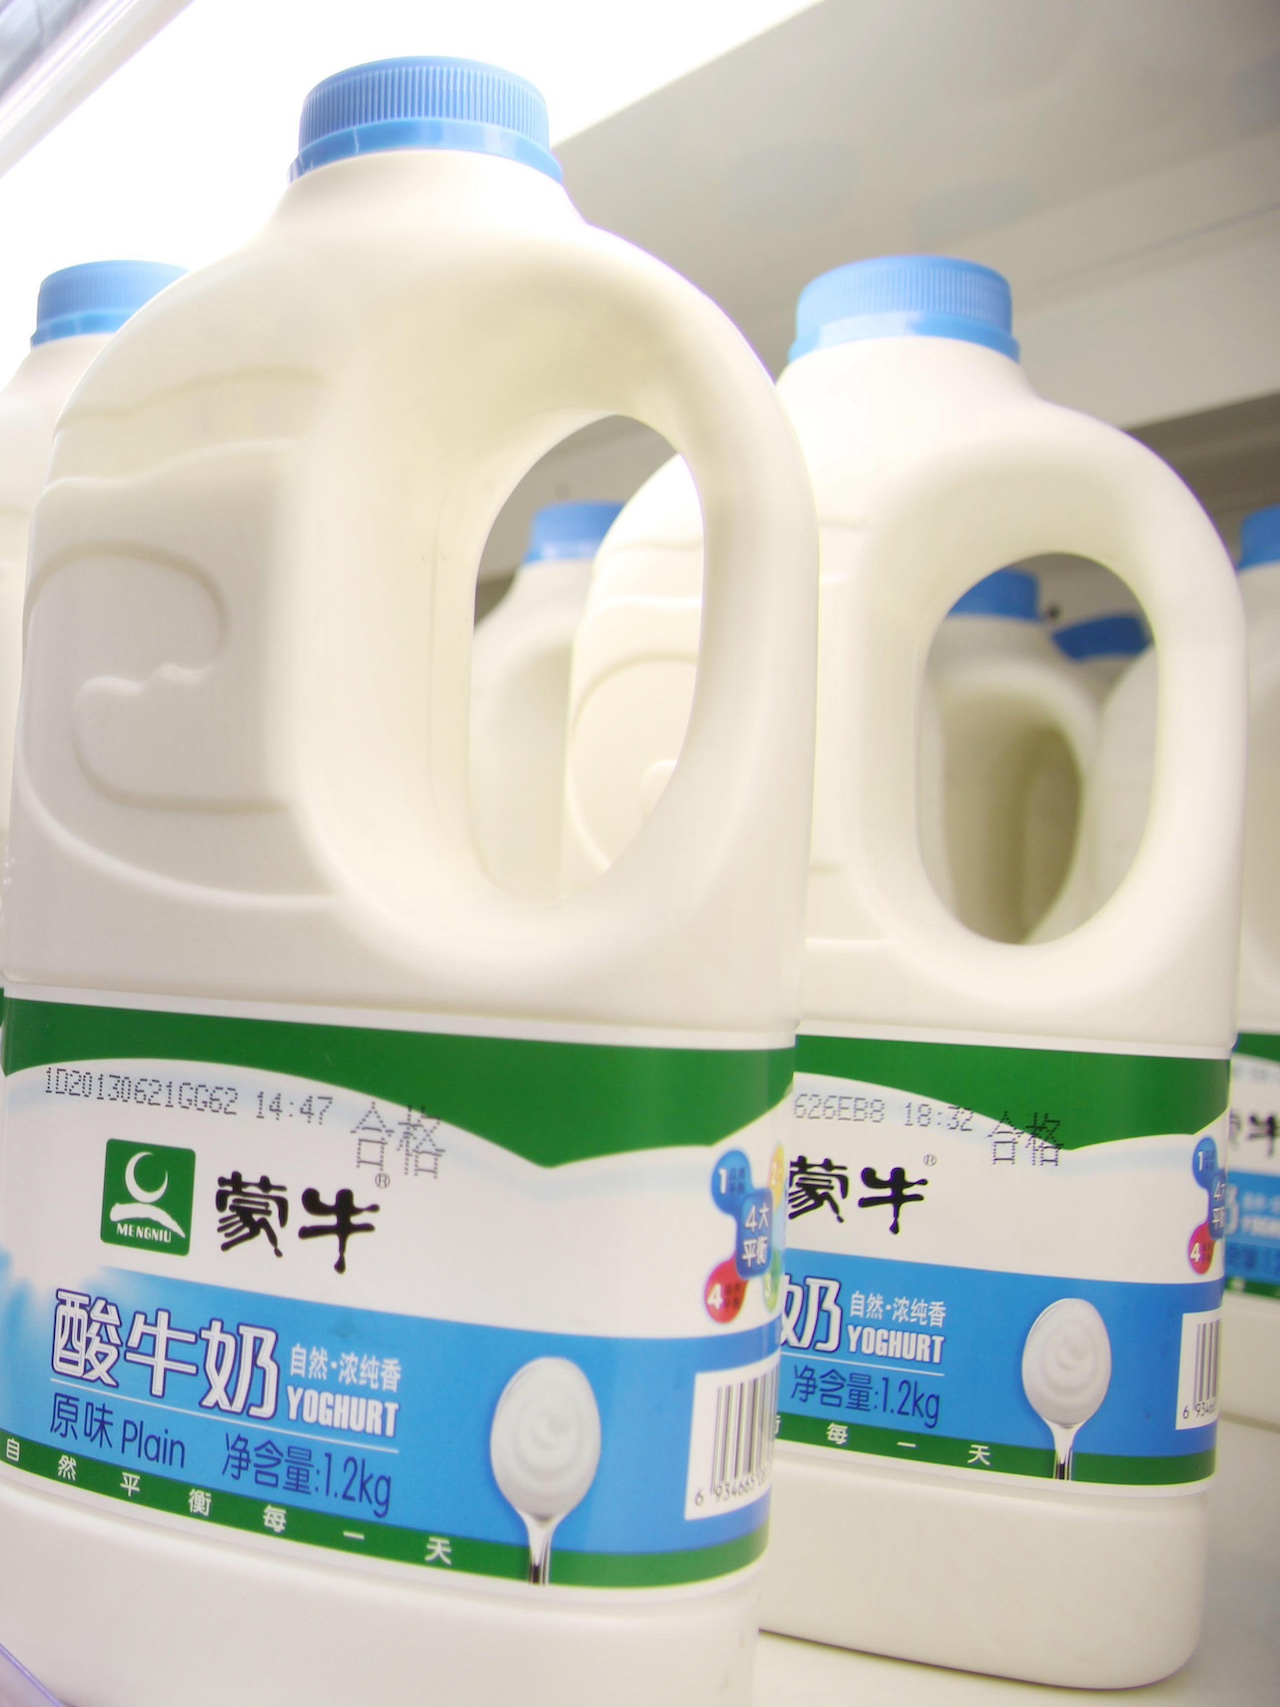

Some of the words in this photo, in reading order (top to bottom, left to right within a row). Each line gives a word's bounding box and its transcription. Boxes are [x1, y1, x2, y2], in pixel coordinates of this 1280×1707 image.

[256, 1091, 333, 1125] 14:47
[904, 1102, 974, 1132] 18:32
[350, 1101, 446, 1179] 合格
[987, 1110, 1065, 1167] 合格
[214, 1170, 381, 1275] 蒙牛
[788, 1155, 928, 1235] 蒙牛
[116, 1222, 173, 1244] MENGNIU
[707, 1282, 724, 1310] 4
[51, 1288, 281, 1420] 酸牛奶
[846, 1325, 946, 1366] YOGHURT
[50, 1392, 113, 1449] 原味
[121, 1419, 186, 1469] Plain
[286, 1385, 400, 1438] YOGHURT
